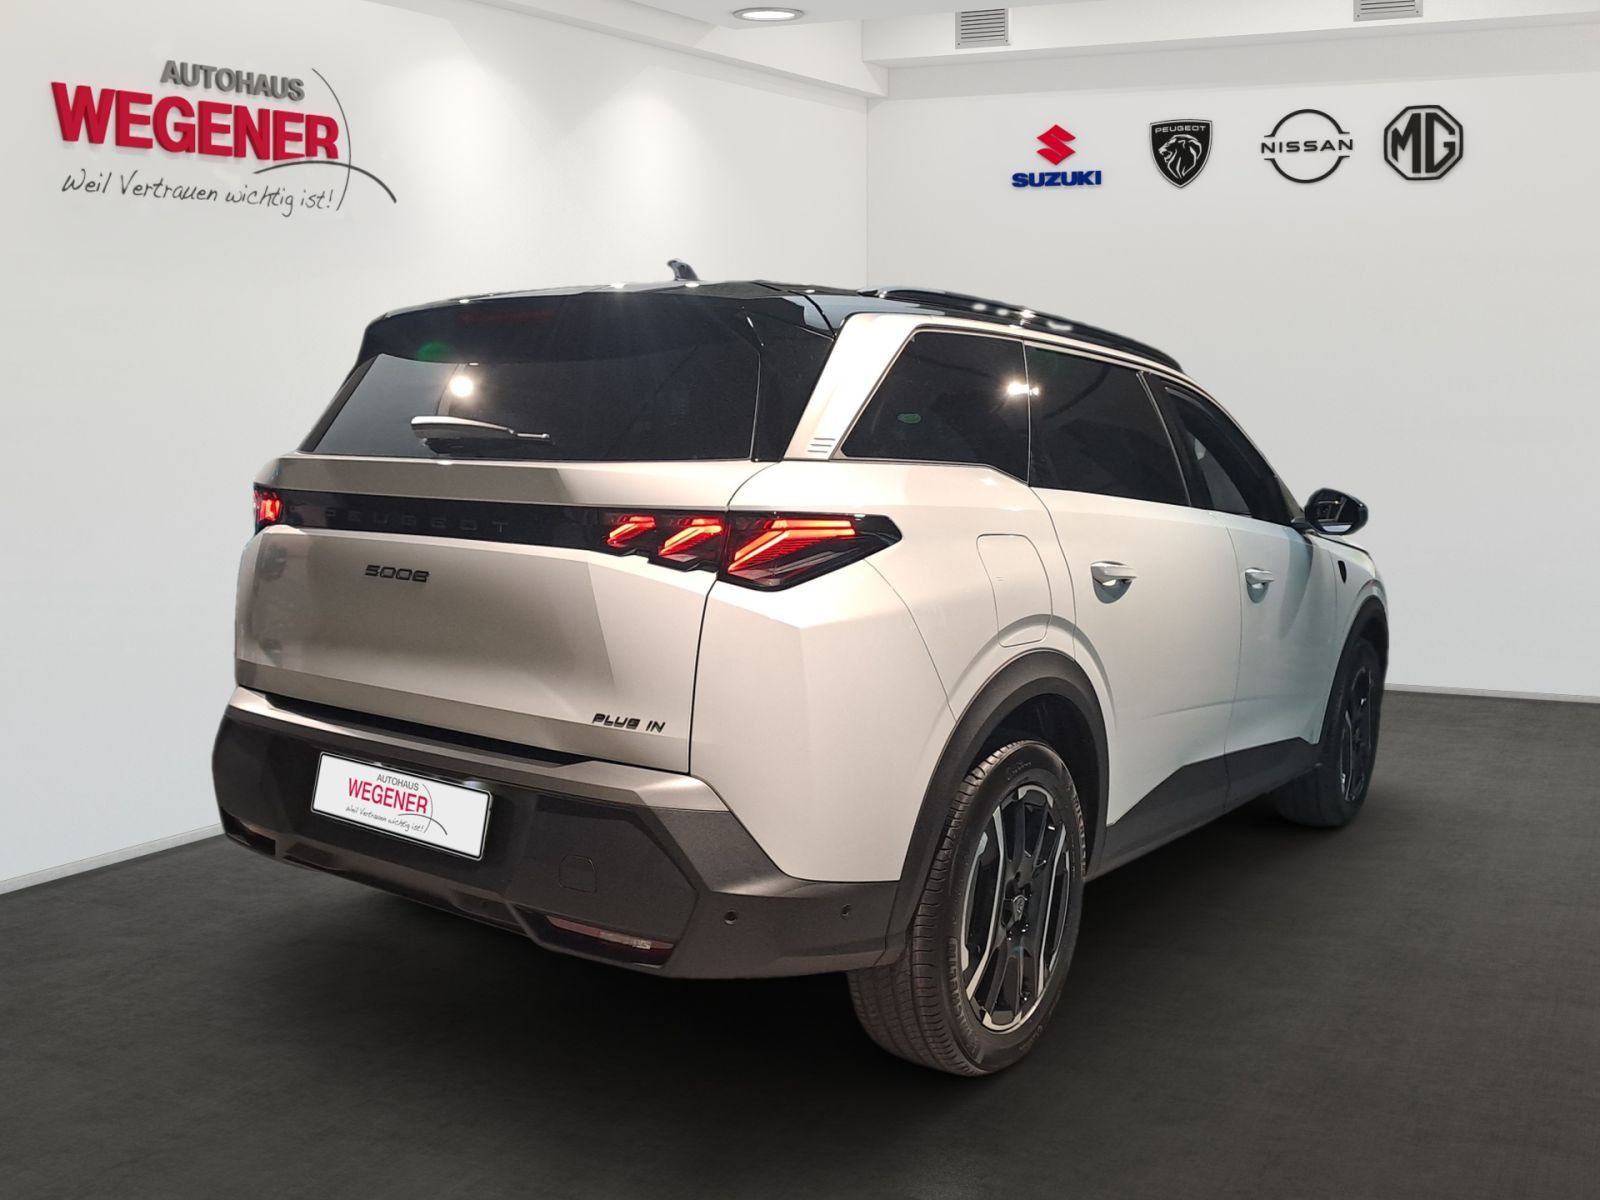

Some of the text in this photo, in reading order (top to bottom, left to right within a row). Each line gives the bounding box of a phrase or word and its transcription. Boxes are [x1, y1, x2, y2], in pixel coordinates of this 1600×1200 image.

[160, 60, 304, 101] AUTOHAUS
[51, 82, 339, 161] WEGENER
[1155, 126, 1207, 134] PEUGEOT
[1261, 138, 1353, 154] NISSAN
[1391, 112, 1456, 173] MG
[1012, 170, 1102, 187] SUZUKI
[63, 169, 334, 217] Weil Vertrauen wichtig ist!
[327, 508, 508, 533] PEUGEOT
[364, 565, 429, 582] 5008
[592, 713, 666, 733] PLUG IN
[377, 774, 419, 791] AUTOHAUS
[349, 778, 428, 814] WEGENER
